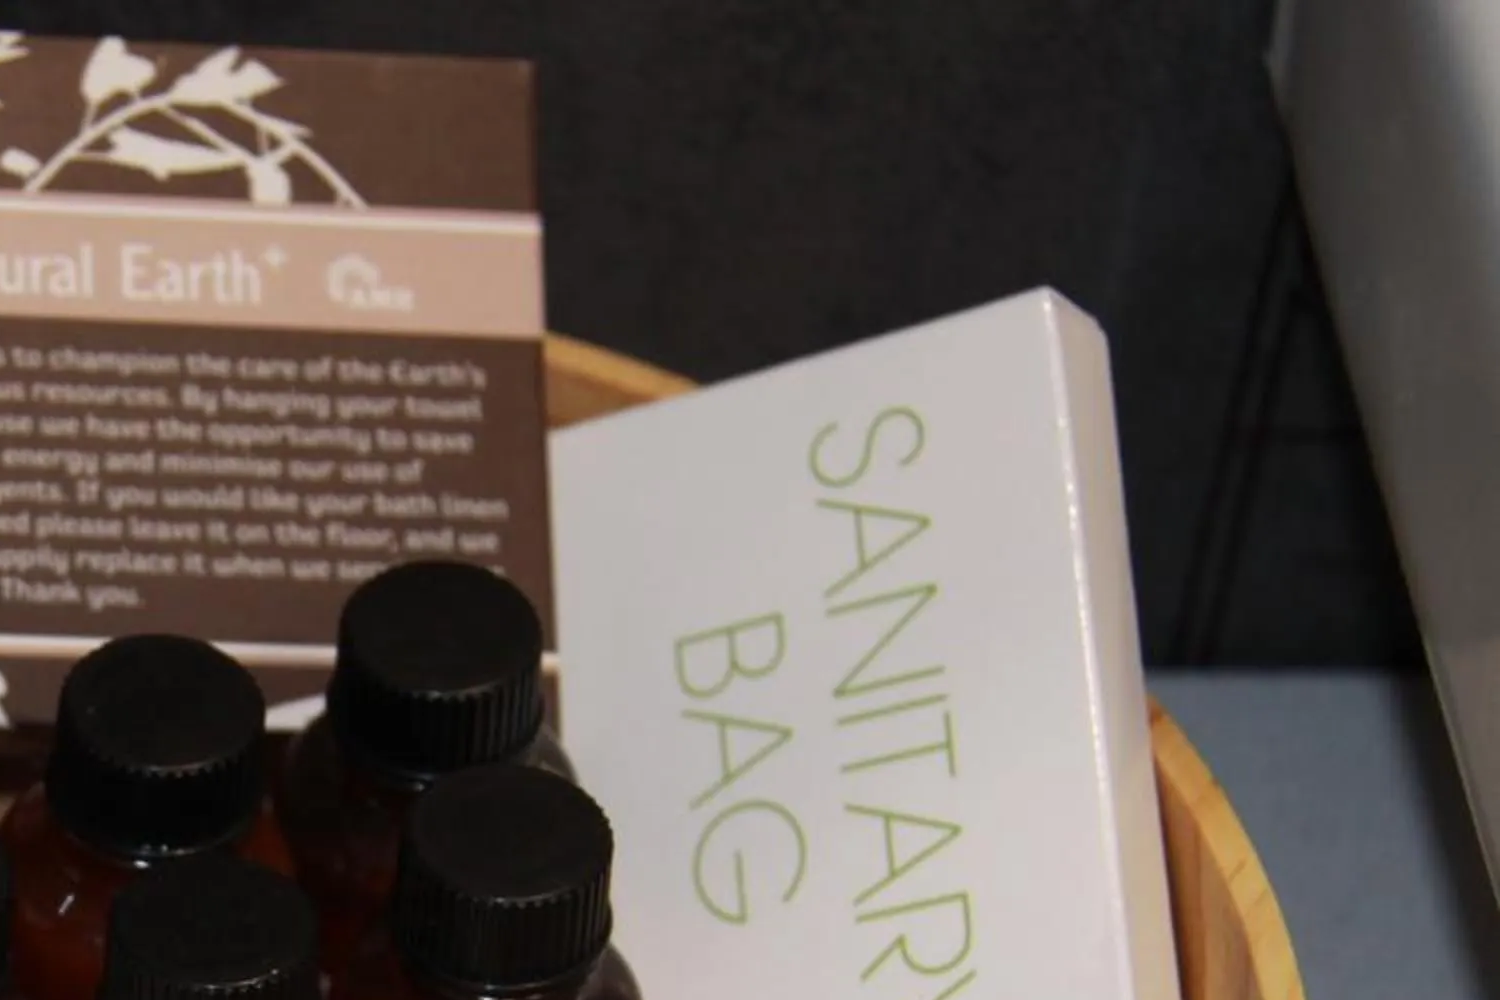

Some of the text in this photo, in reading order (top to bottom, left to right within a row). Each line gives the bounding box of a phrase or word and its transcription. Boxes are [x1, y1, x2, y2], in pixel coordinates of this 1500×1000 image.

[11, 345, 42, 370] to
[46, 345, 180, 378] champion
[185, 352, 230, 377] the
[236, 357, 298, 381] care
[303, 355, 332, 383] of
[336, 357, 384, 384] the
[30, 382, 171, 408] resources.
[180, 382, 217, 416] By
[221, 385, 330, 420] hanging
[336, 395, 399, 421] your
[38, 416, 80, 438] we
[84, 411, 149, 442] have
[153, 415, 203, 442] the
[206, 422, 372, 455] opportunity
[375, 426, 408, 451] to
[411, 431, 474, 454] save
[1, 448, 99, 477] energy
[104, 449, 155, 474] and
[288, 459, 336, 482] our
[340, 460, 389, 484] use
[393, 457, 425, 485] of
[75, 477, 99, 504] If
[104, 485, 156, 513] you
[161, 484, 244, 512] would
[249, 485, 299, 512] like
[304, 494, 368, 521] your
[372, 491, 437, 519] bath
[441, 492, 508, 521] linen
[34, 512, 124, 540] please
[127, 515, 200, 541] leave
[205, 519, 230, 545] it
[233, 524, 270, 546] on
[273, 521, 321, 548] the
[403, 527, 455, 554] and
[458, 532, 499, 556] we
[73, 545, 179, 578] replace
[183, 552, 210, 578] it
[212, 552, 286, 580] when
[290, 559, 331, 582] we
[0, 576, 82, 606] Thank
[86, 583, 146, 613] you.
[673, 611, 807, 926] BAG
